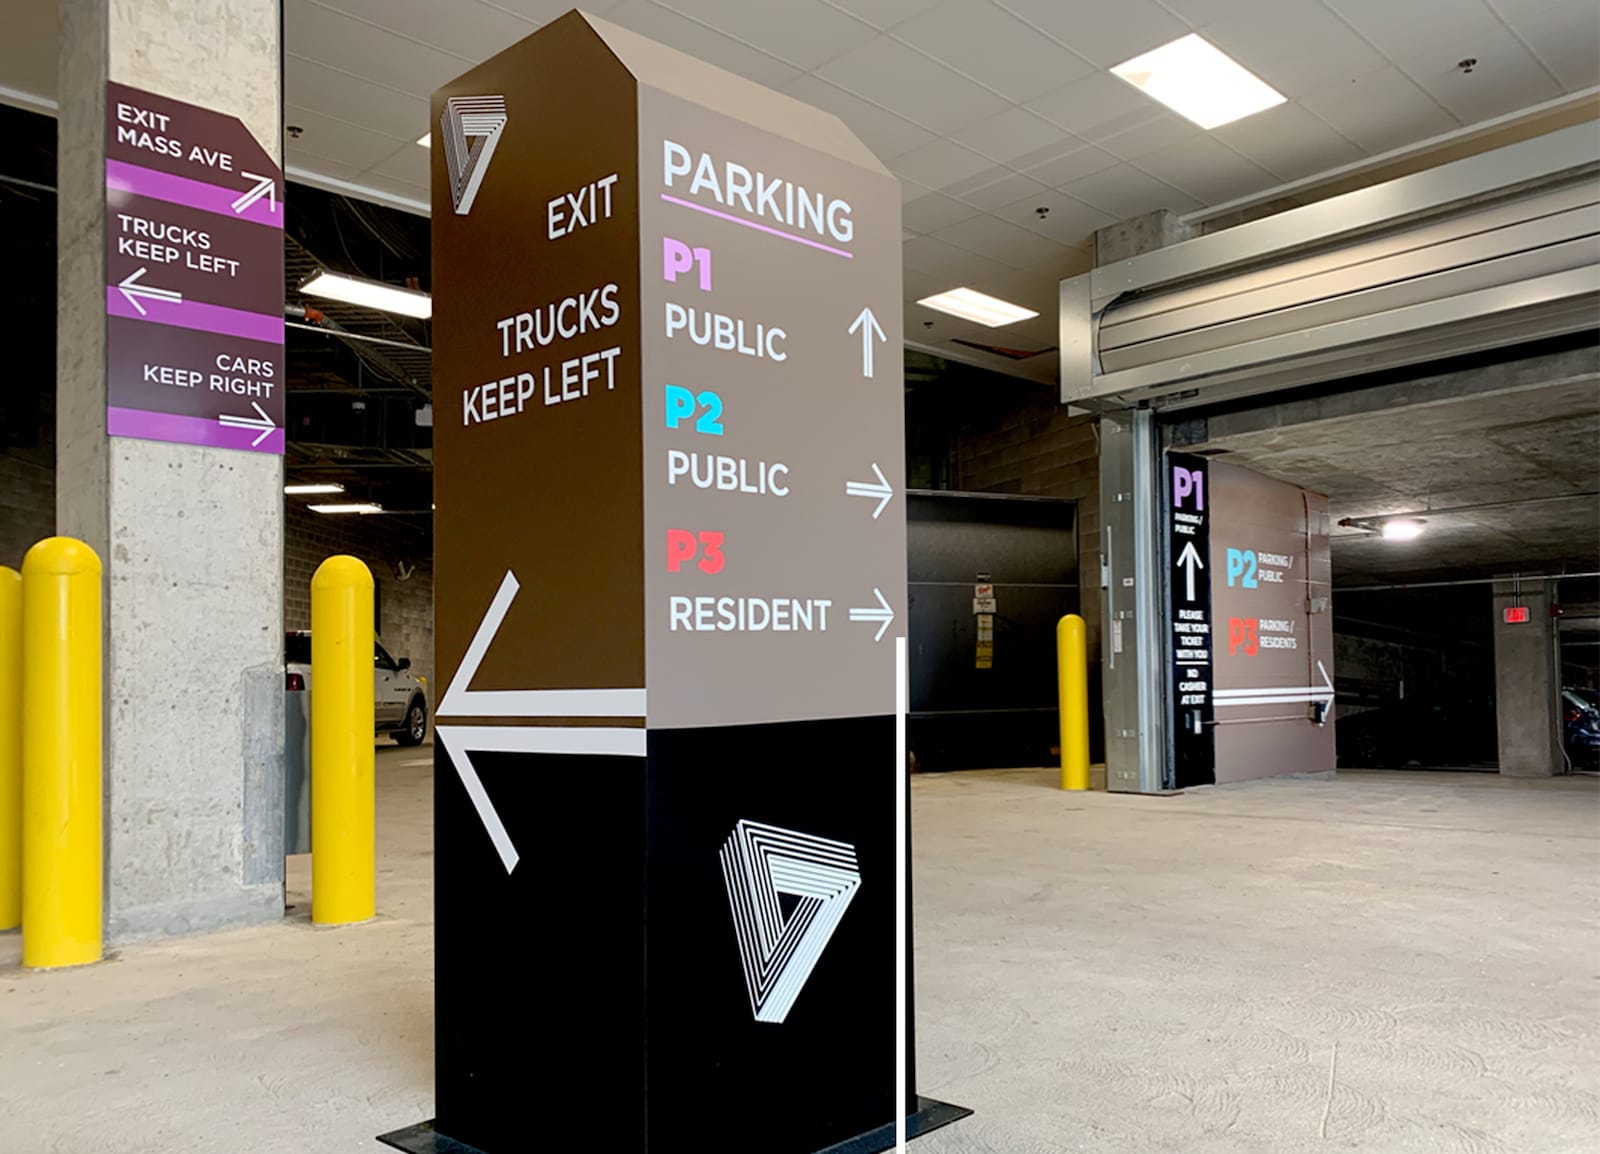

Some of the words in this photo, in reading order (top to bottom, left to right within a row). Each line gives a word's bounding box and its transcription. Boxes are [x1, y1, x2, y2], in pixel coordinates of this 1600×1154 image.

[117, 103, 170, 132] EXIT
[117, 126, 182, 157] MASS
[188, 148, 233, 172] AVE
[547, 174, 618, 240] EXIT
[663, 139, 854, 242] PARKING
[118, 214, 211, 250] TRUCKS
[118, 237, 180, 264] KEEP
[187, 252, 240, 278] LEFT
[663, 237, 712, 292] P1
[497, 283, 620, 357] TRUCKS
[665, 303, 788, 362] PUBLIC
[143, 364, 203, 388] KEEP
[209, 375, 274, 399] RIGHT
[216, 354, 274, 377] CARS
[462, 373, 535, 426] KEEP
[543, 347, 621, 406] LEFT
[664, 384, 724, 435] P2
[667, 450, 790, 497] PUBLIC
[1173, 466, 1204, 511] P1
[666, 529, 725, 574] P3
[1226, 547, 1258, 589] P2
[1258, 569, 1284, 583] PUBLIC
[669, 596, 832, 632] RESIDENT
[1228, 616, 1259, 656] P3
[1259, 636, 1297, 649] RESIDENTS
